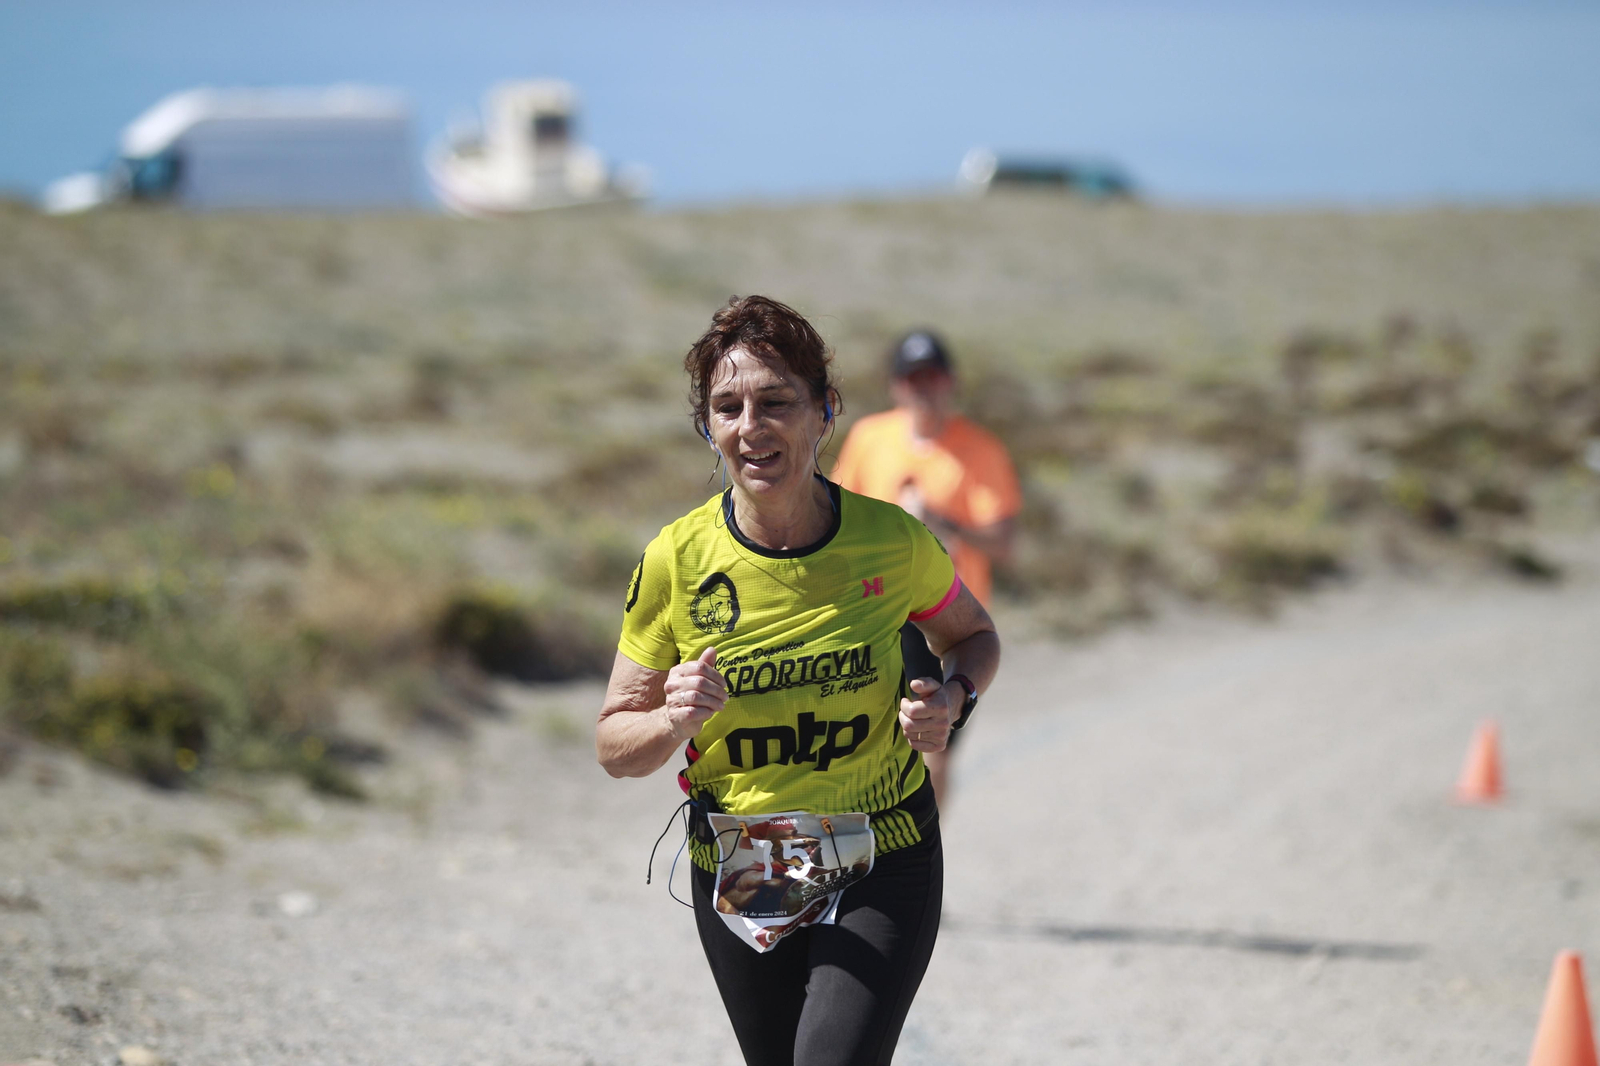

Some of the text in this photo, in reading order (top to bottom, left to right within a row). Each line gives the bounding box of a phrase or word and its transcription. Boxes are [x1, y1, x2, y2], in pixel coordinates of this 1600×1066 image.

[714, 640, 805, 670] Centro Deportivo
[723, 644, 873, 698] SPORTGYM
[820, 683, 834, 698] El
[725, 711, 870, 772] mtp
